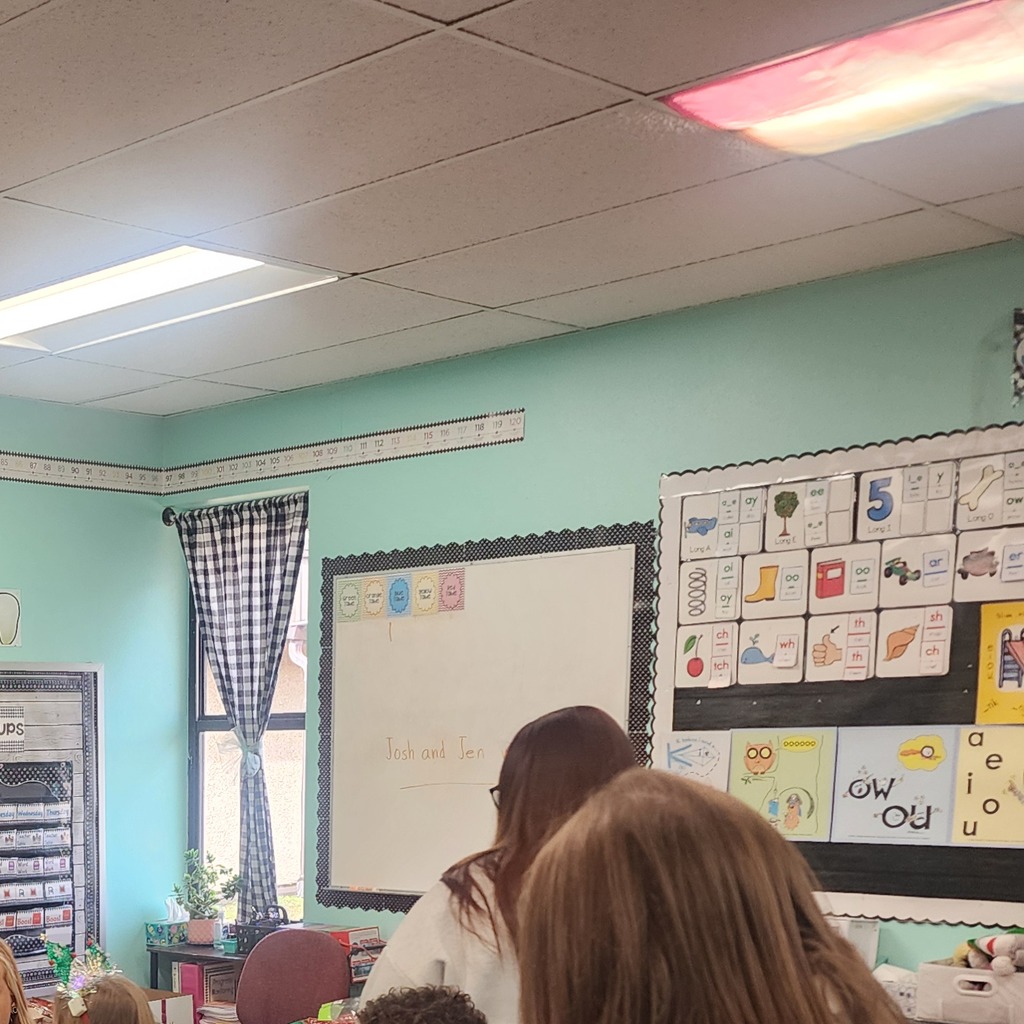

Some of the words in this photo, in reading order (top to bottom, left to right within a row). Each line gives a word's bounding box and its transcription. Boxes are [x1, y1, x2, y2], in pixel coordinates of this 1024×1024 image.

[475, 422, 485, 431] 118
[492, 420, 503, 429] 119
[509, 417, 522, 426] 120
[867, 476, 894, 522] 5
[929, 559, 942, 567] ar
[855, 617, 866, 628] th
[930, 611, 943, 622] sh
[716, 629, 729, 639] ch
[779, 640, 795, 649] wh
[926, 645, 940, 656] ch
[852, 651, 863, 661] th
[968, 732, 984, 747] a
[385, 737, 416, 761] Josh
[421, 740, 446, 761] and
[459, 735, 485, 760] Jen
[985, 753, 1003, 770] e
[967, 772, 973, 794] i
[982, 798, 1000, 815] o
[17, 810, 43, 818] Wednesday
[962, 821, 978, 836] u
